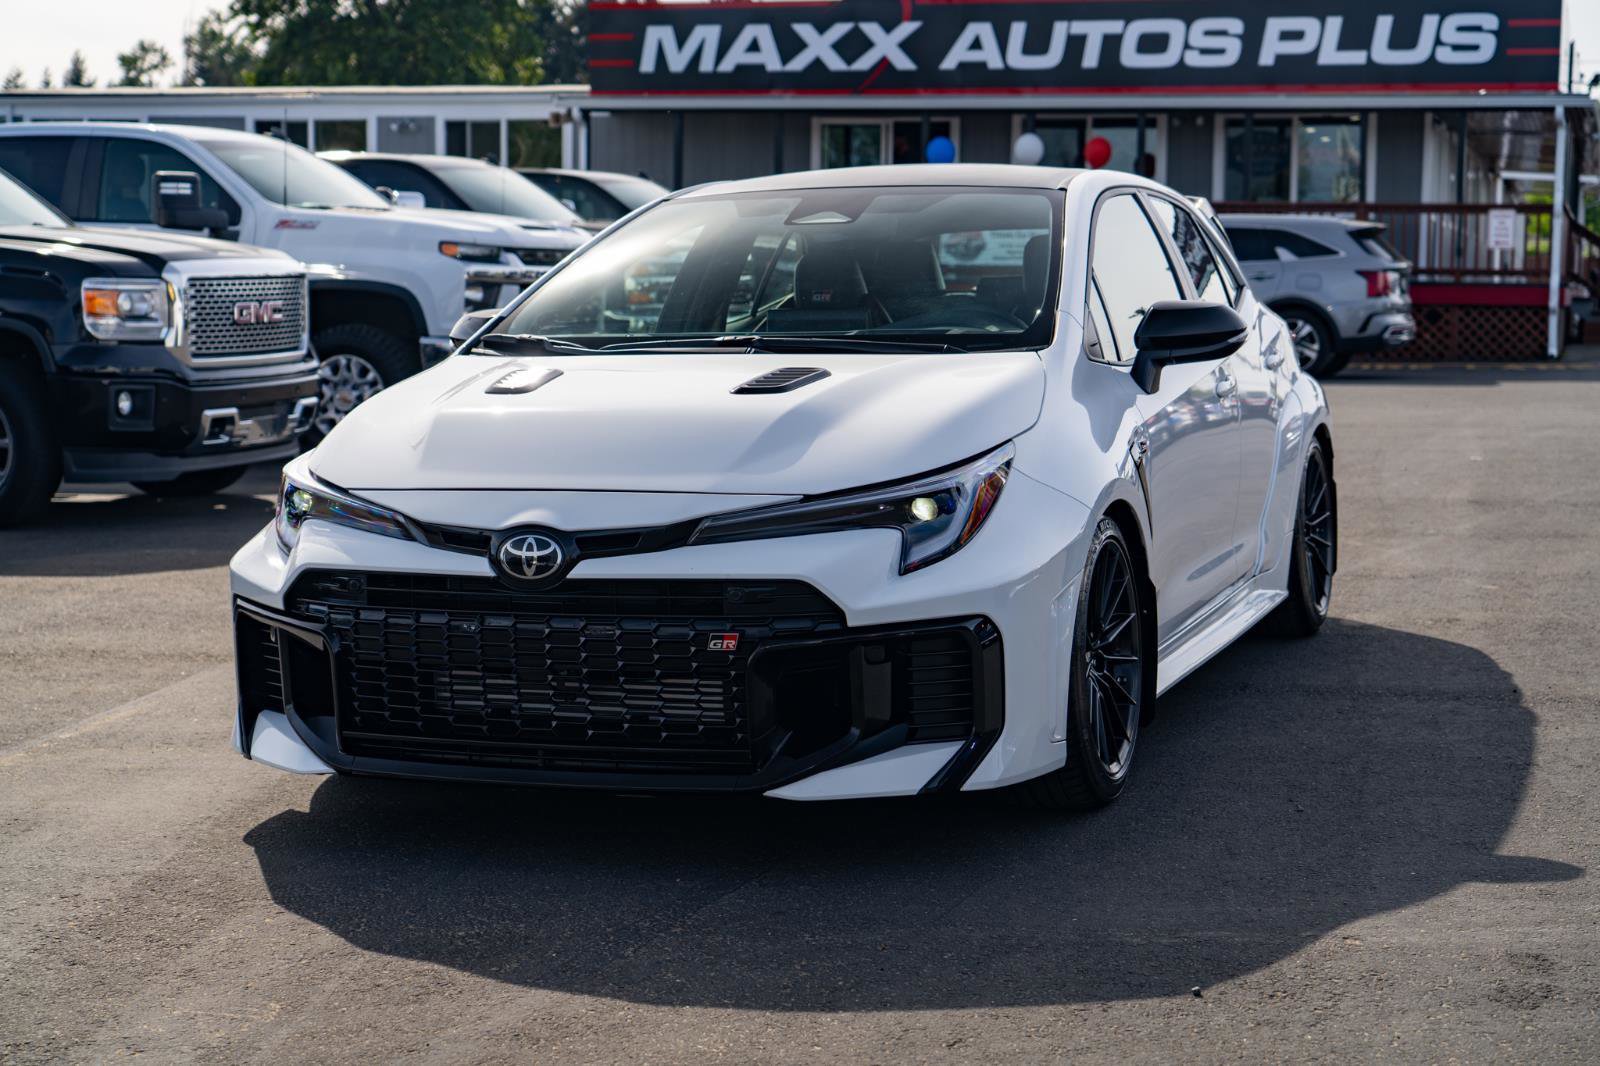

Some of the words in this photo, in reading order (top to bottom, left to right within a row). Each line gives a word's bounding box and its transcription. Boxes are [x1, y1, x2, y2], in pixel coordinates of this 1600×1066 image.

[639, 20, 923, 74] MAXX
[938, 17, 1245, 70] AUTOS
[1257, 12, 1500, 66] PLUS
[233, 300, 284, 324] GMC
[709, 637, 737, 649] GR
